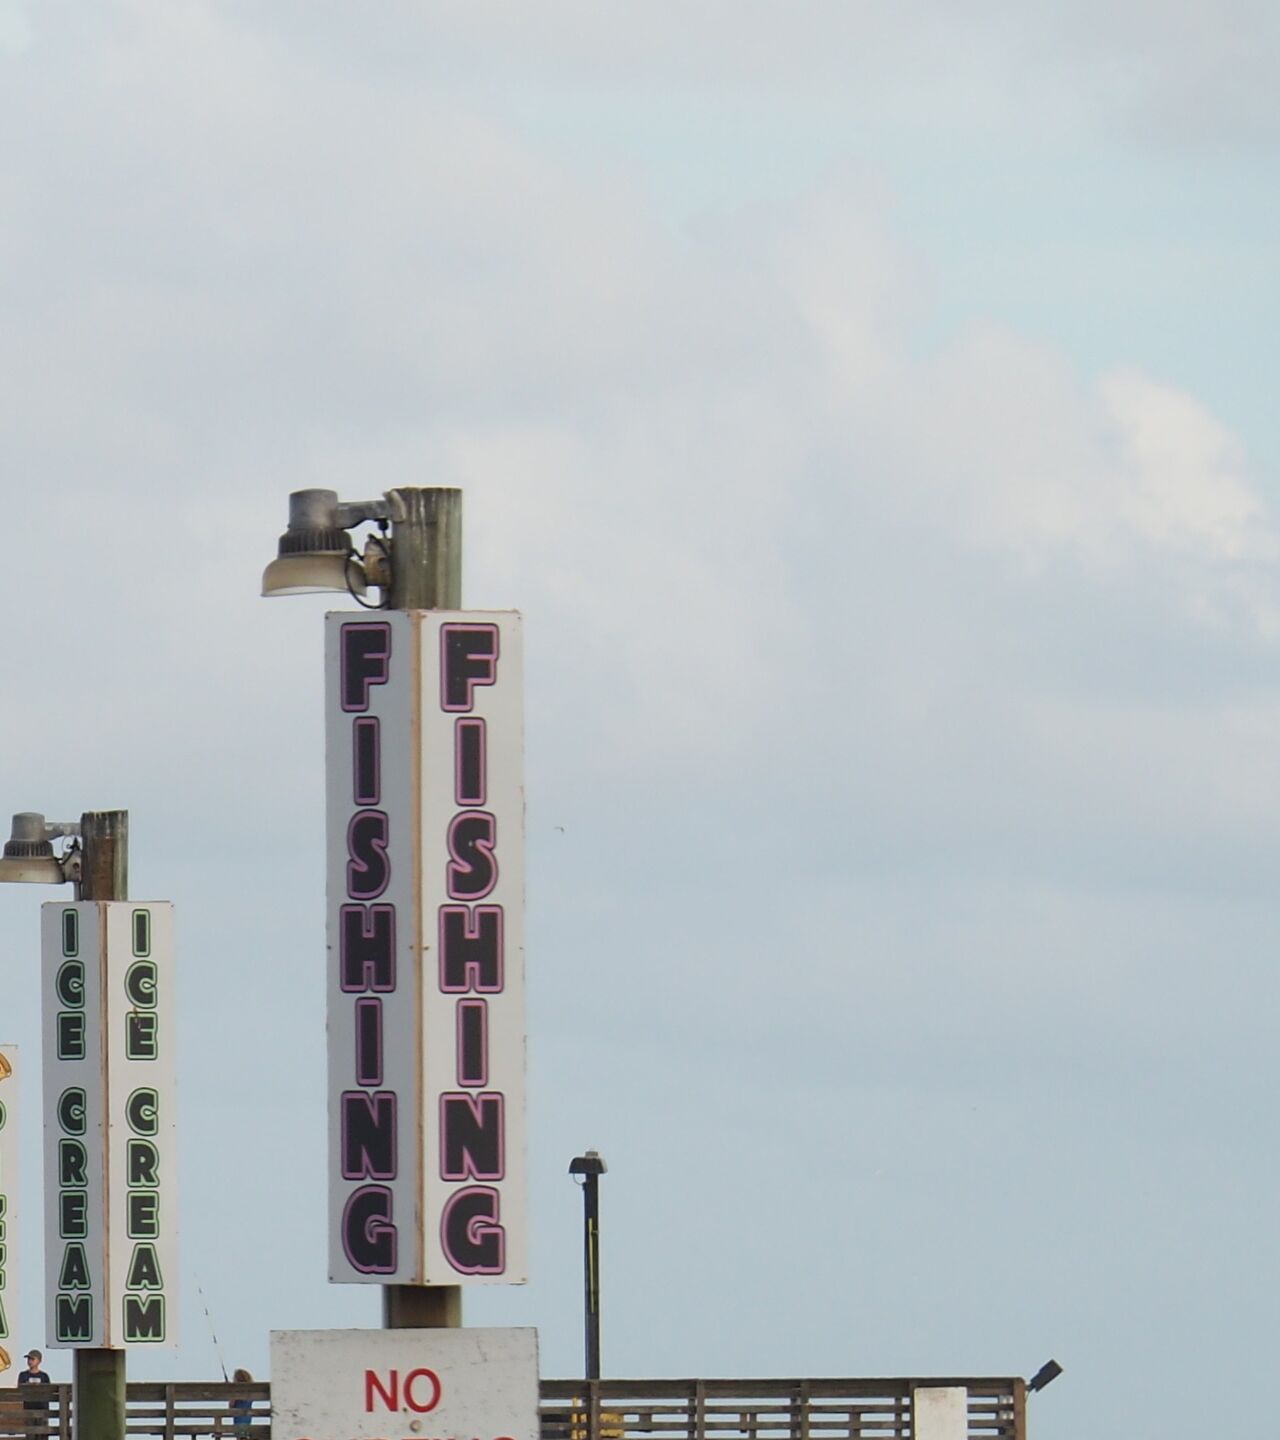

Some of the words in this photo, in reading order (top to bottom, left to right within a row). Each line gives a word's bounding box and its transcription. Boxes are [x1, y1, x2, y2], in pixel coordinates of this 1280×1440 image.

[56, 908, 86, 1061] ICE
[125, 908, 159, 1061] ICE
[340, 621, 397, 1275] FISHING
[438, 621, 506, 1276] FISHING
[55, 1086, 93, 1344] CREAM
[122, 1086, 167, 1344] CREAM
[364, 1368, 442, 1414] NO
